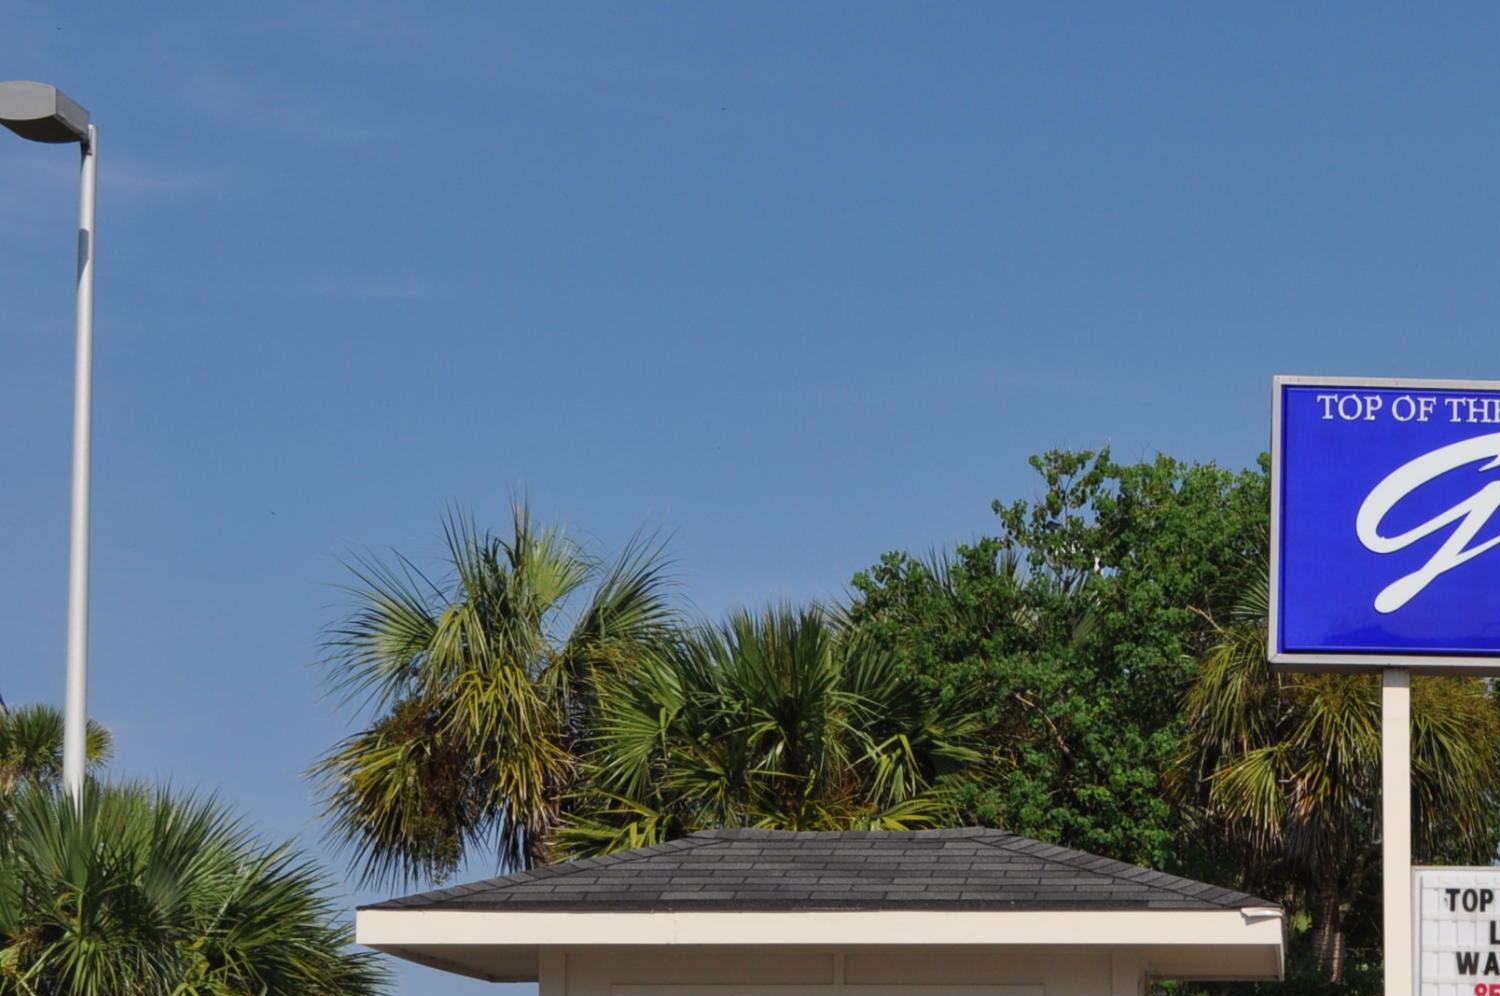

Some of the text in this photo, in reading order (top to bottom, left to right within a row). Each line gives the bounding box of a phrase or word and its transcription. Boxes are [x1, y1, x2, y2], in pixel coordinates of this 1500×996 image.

[1316, 394, 1382, 421] TOP
[1391, 395, 1437, 422] OF
[1446, 888, 1494, 912] TOP
